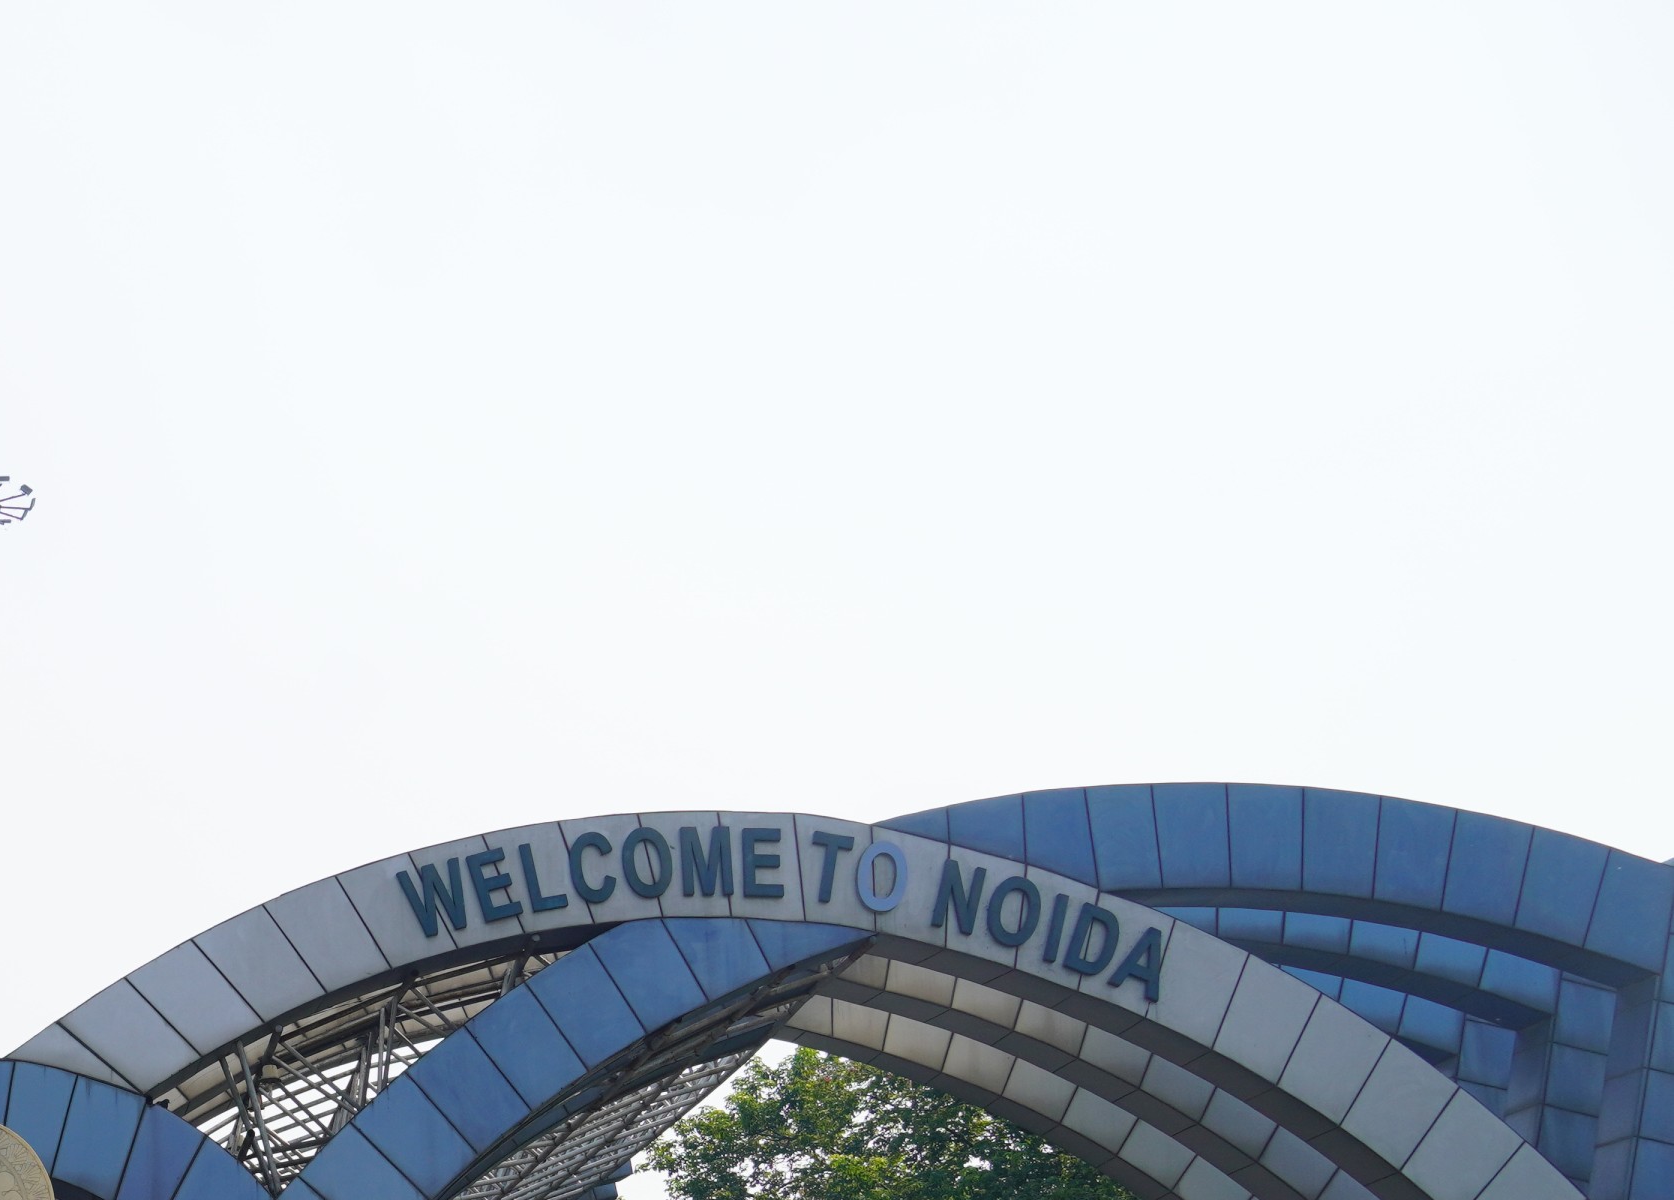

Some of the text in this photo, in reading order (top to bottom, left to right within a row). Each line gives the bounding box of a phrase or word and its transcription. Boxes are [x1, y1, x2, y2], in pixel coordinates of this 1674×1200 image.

[396, 826, 1163, 1004] WELCOME TO NOIDA
